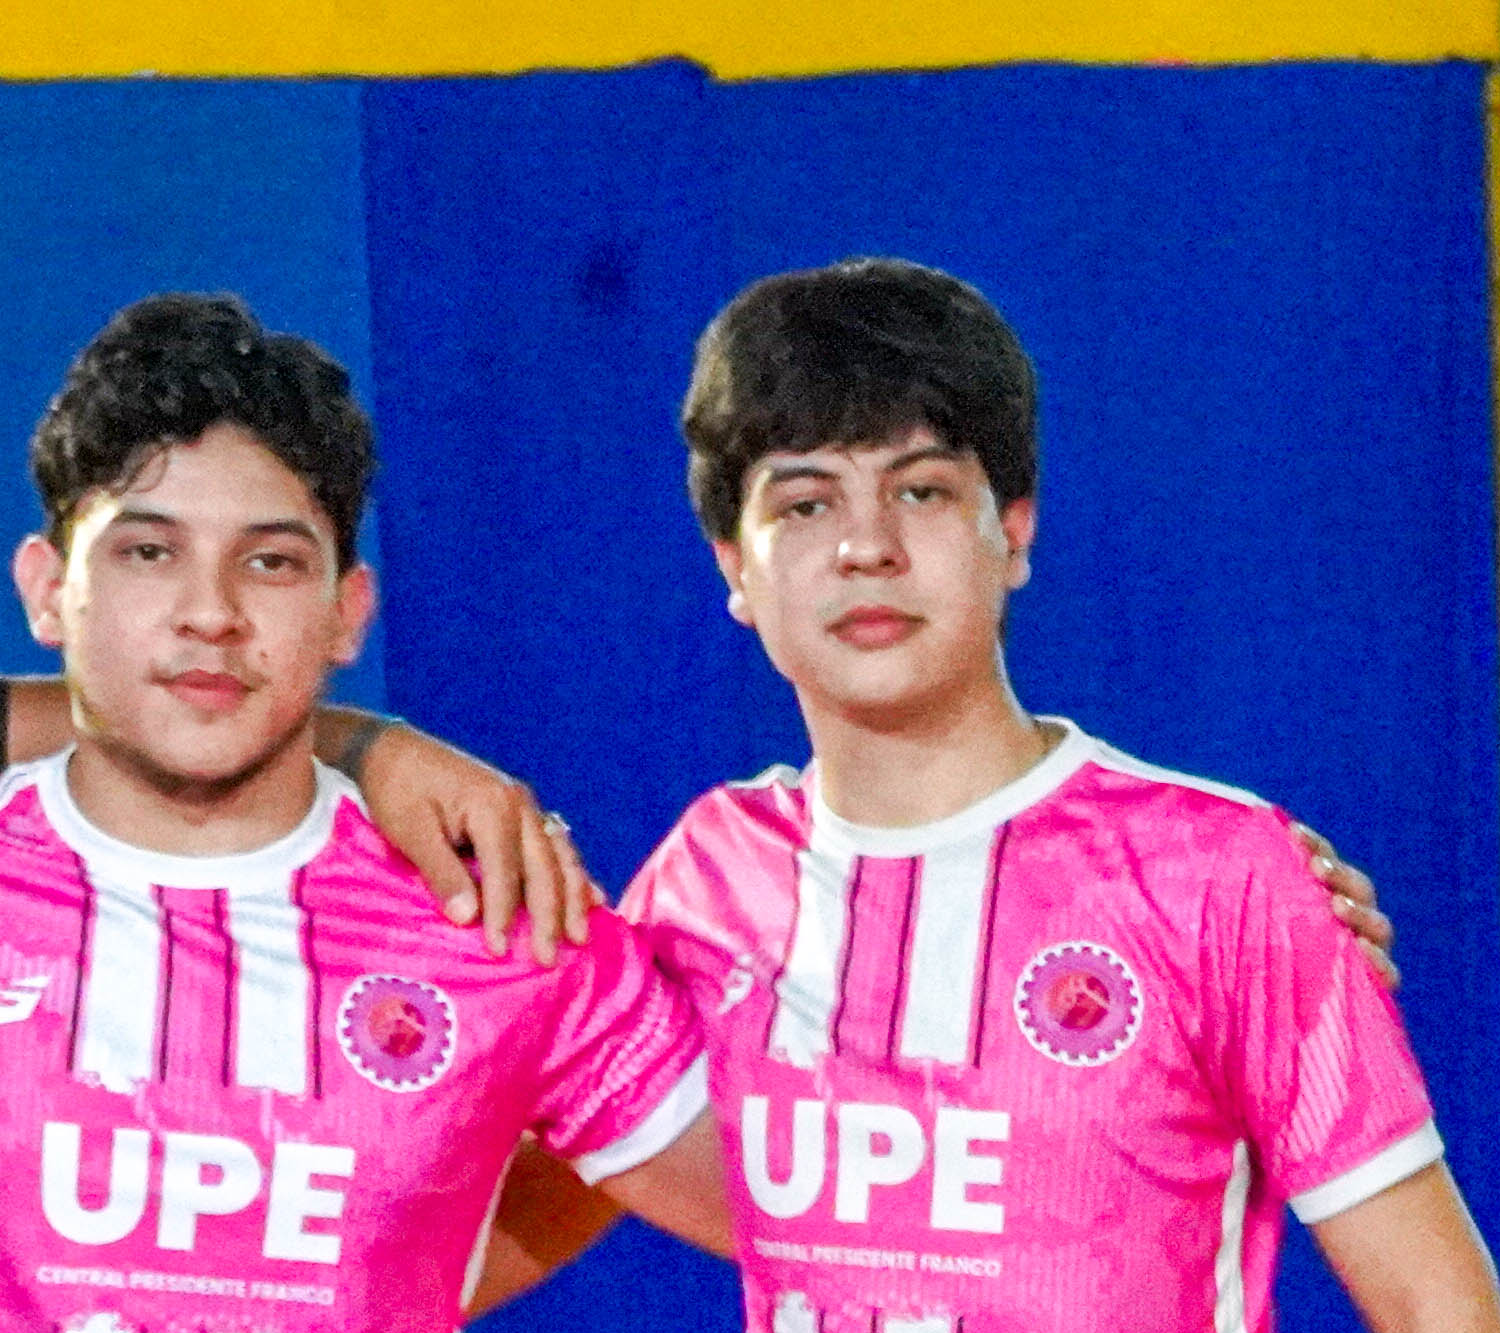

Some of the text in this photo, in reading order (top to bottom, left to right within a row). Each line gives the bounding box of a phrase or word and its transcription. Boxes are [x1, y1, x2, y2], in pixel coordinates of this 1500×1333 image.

[40, 1122, 356, 1264] UPE
[741, 1096, 1010, 1234] UPE
[919, 1253, 1000, 1278] FRANCO
